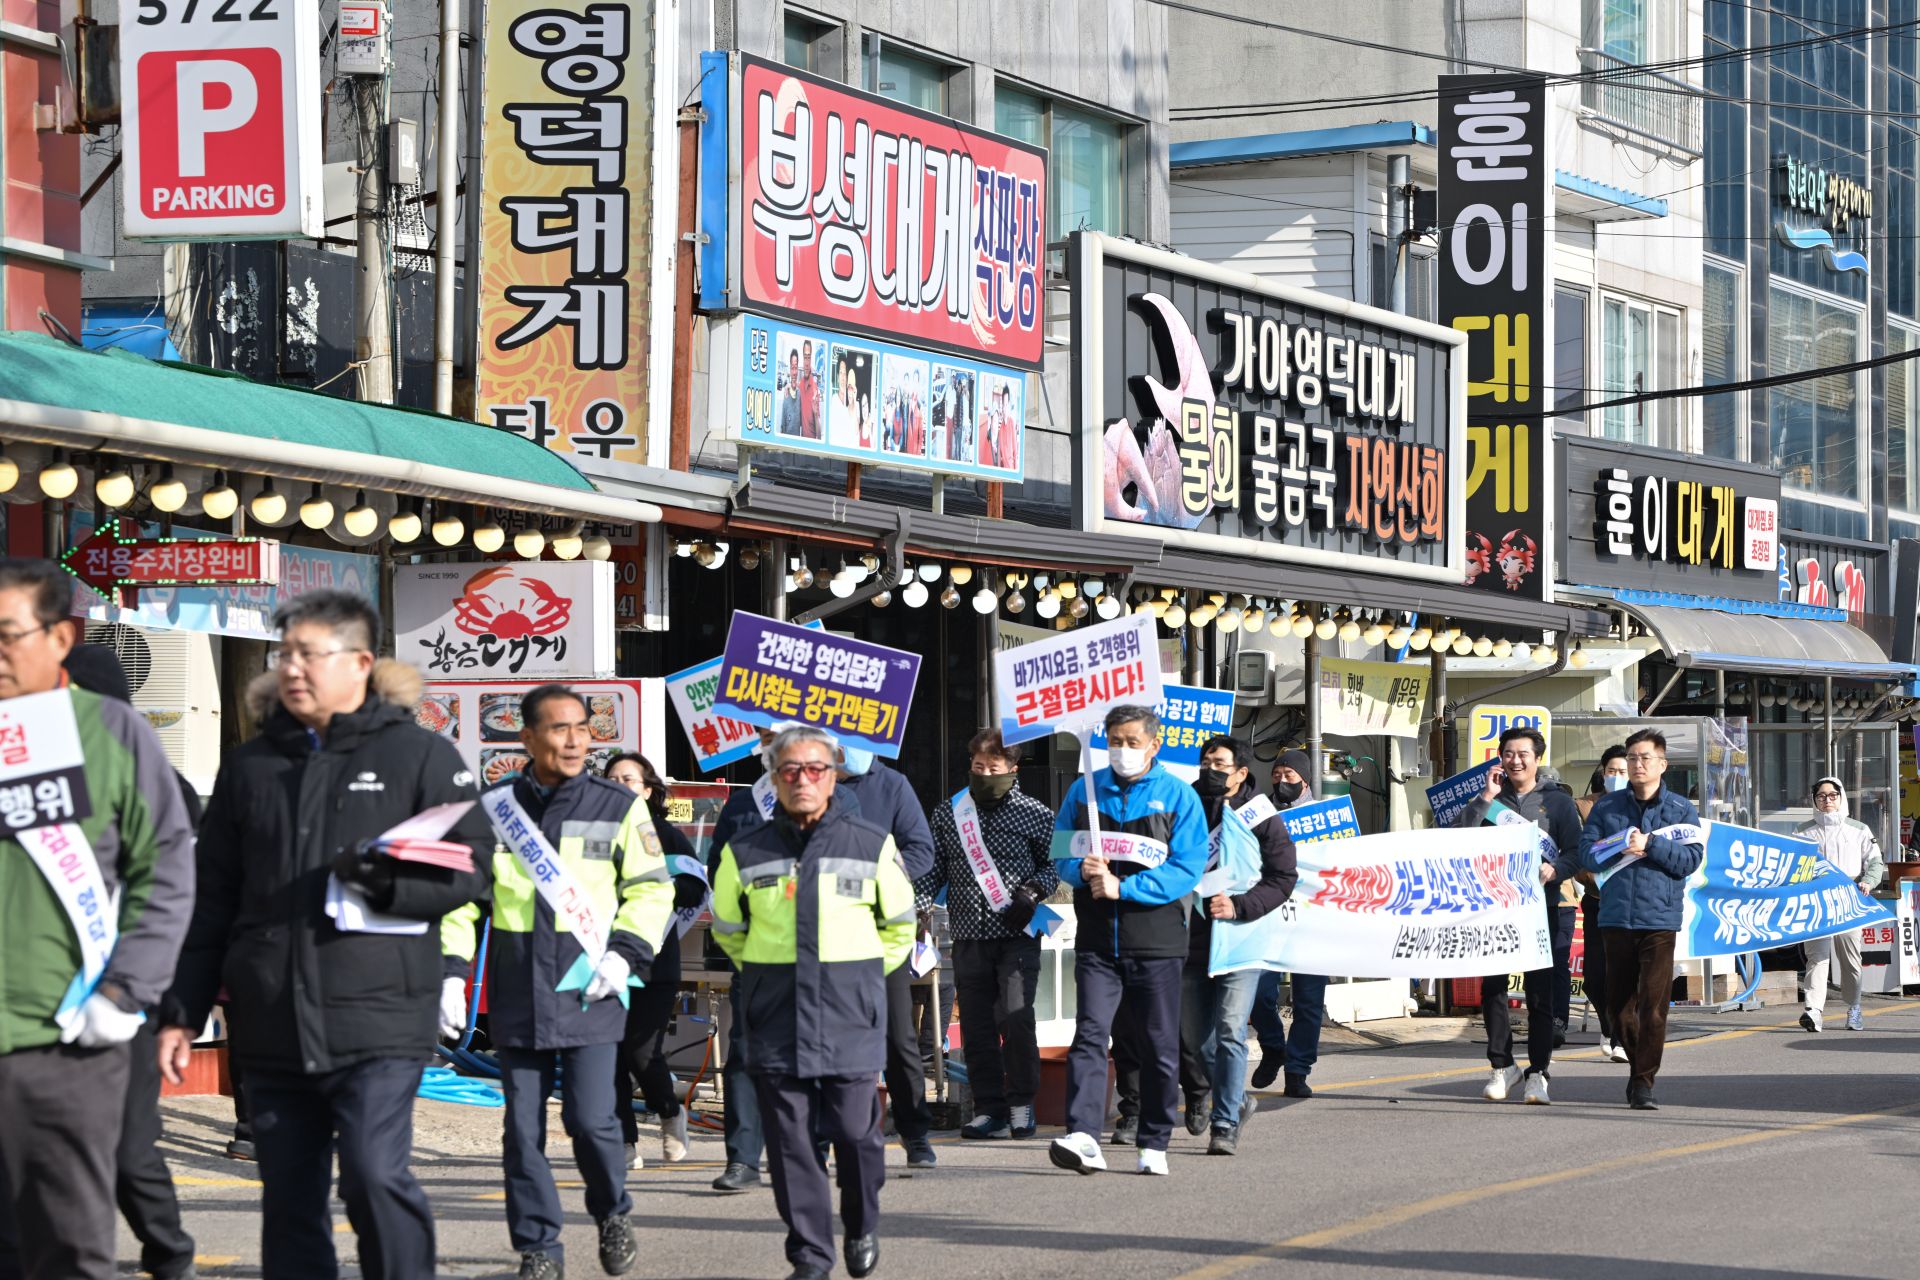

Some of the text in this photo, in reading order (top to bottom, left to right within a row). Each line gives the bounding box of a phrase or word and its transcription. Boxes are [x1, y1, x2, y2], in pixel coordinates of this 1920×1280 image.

[177, 60, 258, 177] P
[153, 184, 274, 212] PARKING
[499, 4, 630, 370] 영덕대게
[752, 88, 1040, 331] 부성대게 직판장
[1829, 173, 1872, 232] 영덕대게
[1451, 91, 1532, 513] 훈이대게
[751, 328, 769, 373] 단골
[1223, 311, 1416, 425] 가야영덕대게
[746, 387, 772, 433] 연예인
[1180, 398, 1445, 542] 물회 물곰국 자연산회
[85, 547, 254, 579] 전용주차장완비
[1751, 539, 1769, 561] 초장집
[419, 625, 567, 674] 황금대게
[757, 630, 887, 693] 건전한 영업문화
[1014, 645, 1084, 688] 바가지요금,
[1086, 628, 1141, 669] 호객행위
[725, 665, 899, 740] 다시찾는 강구만들기
[1015, 661, 1146, 727] 근절합시다!
[1200, 701, 1230, 726] 함께
[1387, 676, 1421, 709] 매운탕
[1326, 806, 1353, 828] 함께
[1430, 787, 1456, 810] 모두의
[492, 799, 561, 885] 호객행위
[961, 819, 990, 876] 다시찾고
